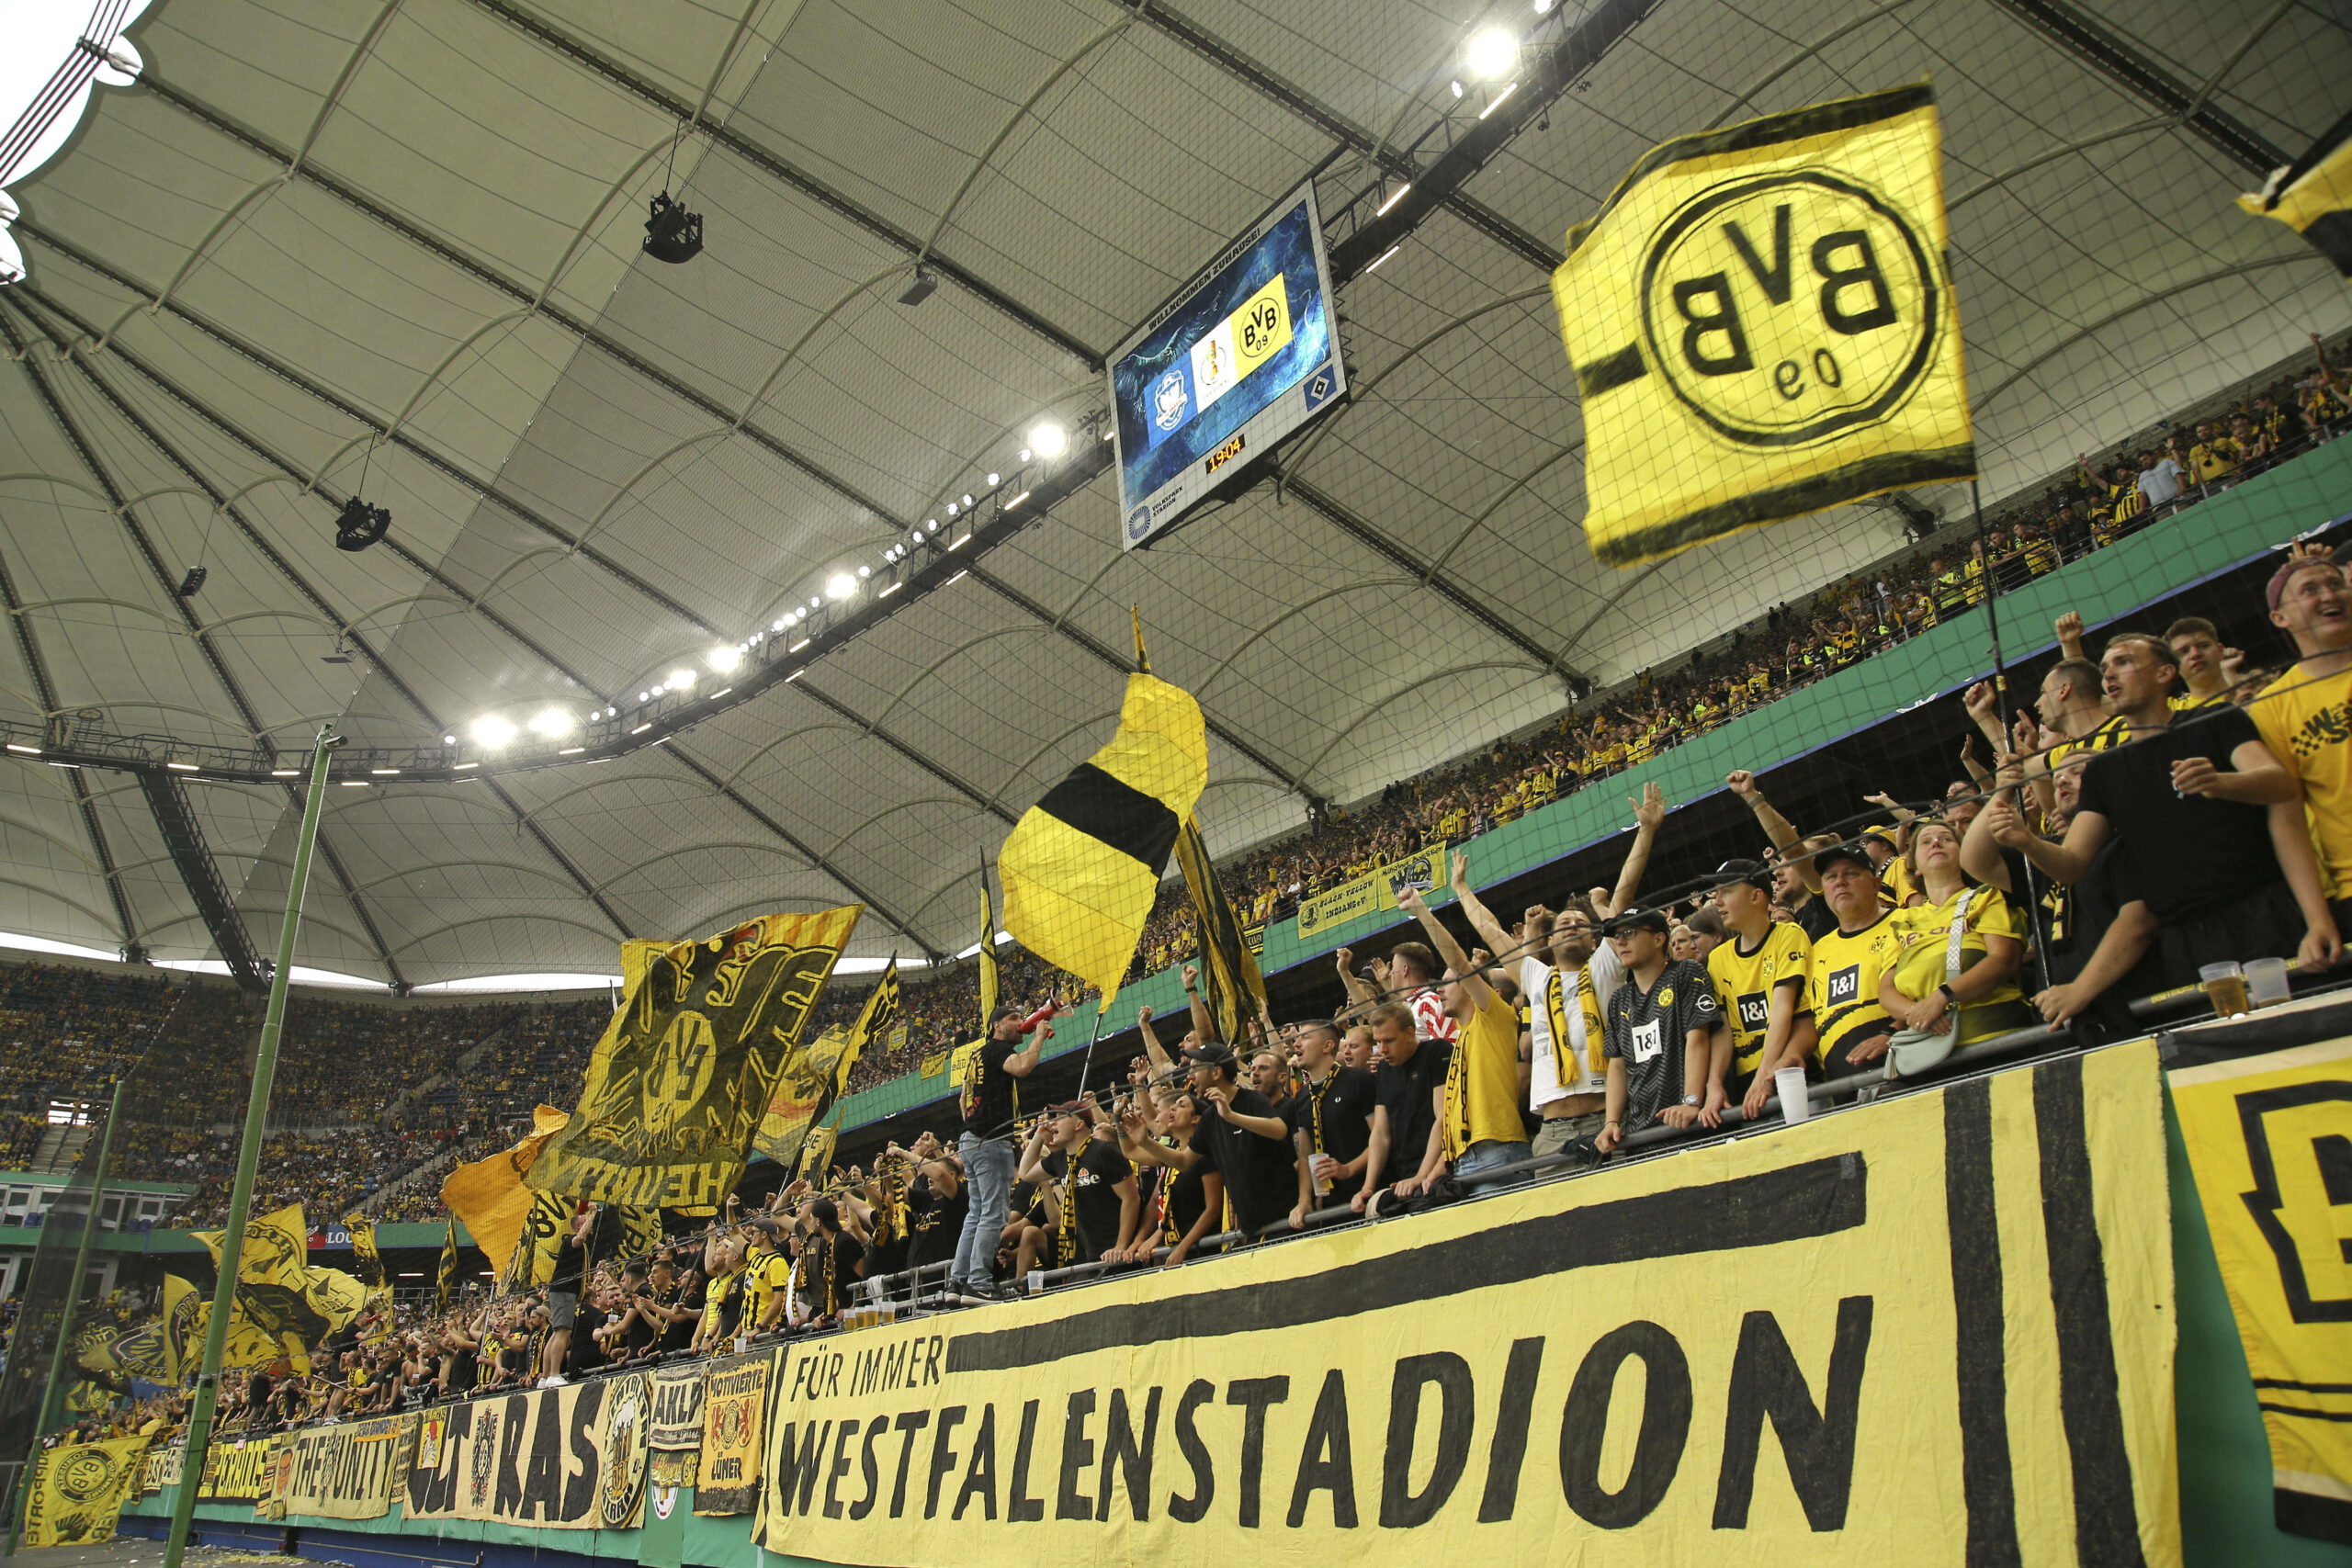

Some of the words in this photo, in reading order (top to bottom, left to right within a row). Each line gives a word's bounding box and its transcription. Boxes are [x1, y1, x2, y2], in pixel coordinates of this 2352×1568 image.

[1148, 271, 1212, 332] WILLKOMMEN
[1212, 228, 1261, 276] ZUHAUSE!
[1244, 304, 1277, 347] BVB
[1255, 335, 1269, 352] 09
[1209, 437, 1241, 473] 19:04
[1151, 485, 1183, 511] VOLKSPARK
[1152, 497, 1177, 517] STADION
[1326, 900, 1357, 919] INDIANS
[1830, 972, 1856, 998] 1&1
[1739, 998, 1769, 1023] 1&1
[1060, 1174, 1102, 1188] esse
[325, 1232, 353, 1245] LOC
[709, 1368, 763, 1399] MOTIVIERTE
[790, 1345, 843, 1402] FÜR
[850, 1336, 941, 1397] IMMER
[778, 1295, 1874, 1532] WESTFALENSTADION
[407, 1381, 606, 1521] ULTRAS
[711, 1451, 742, 1482] LÜNER
[292, 1435, 327, 1499] THE
[334, 1433, 397, 1501] UNITY
